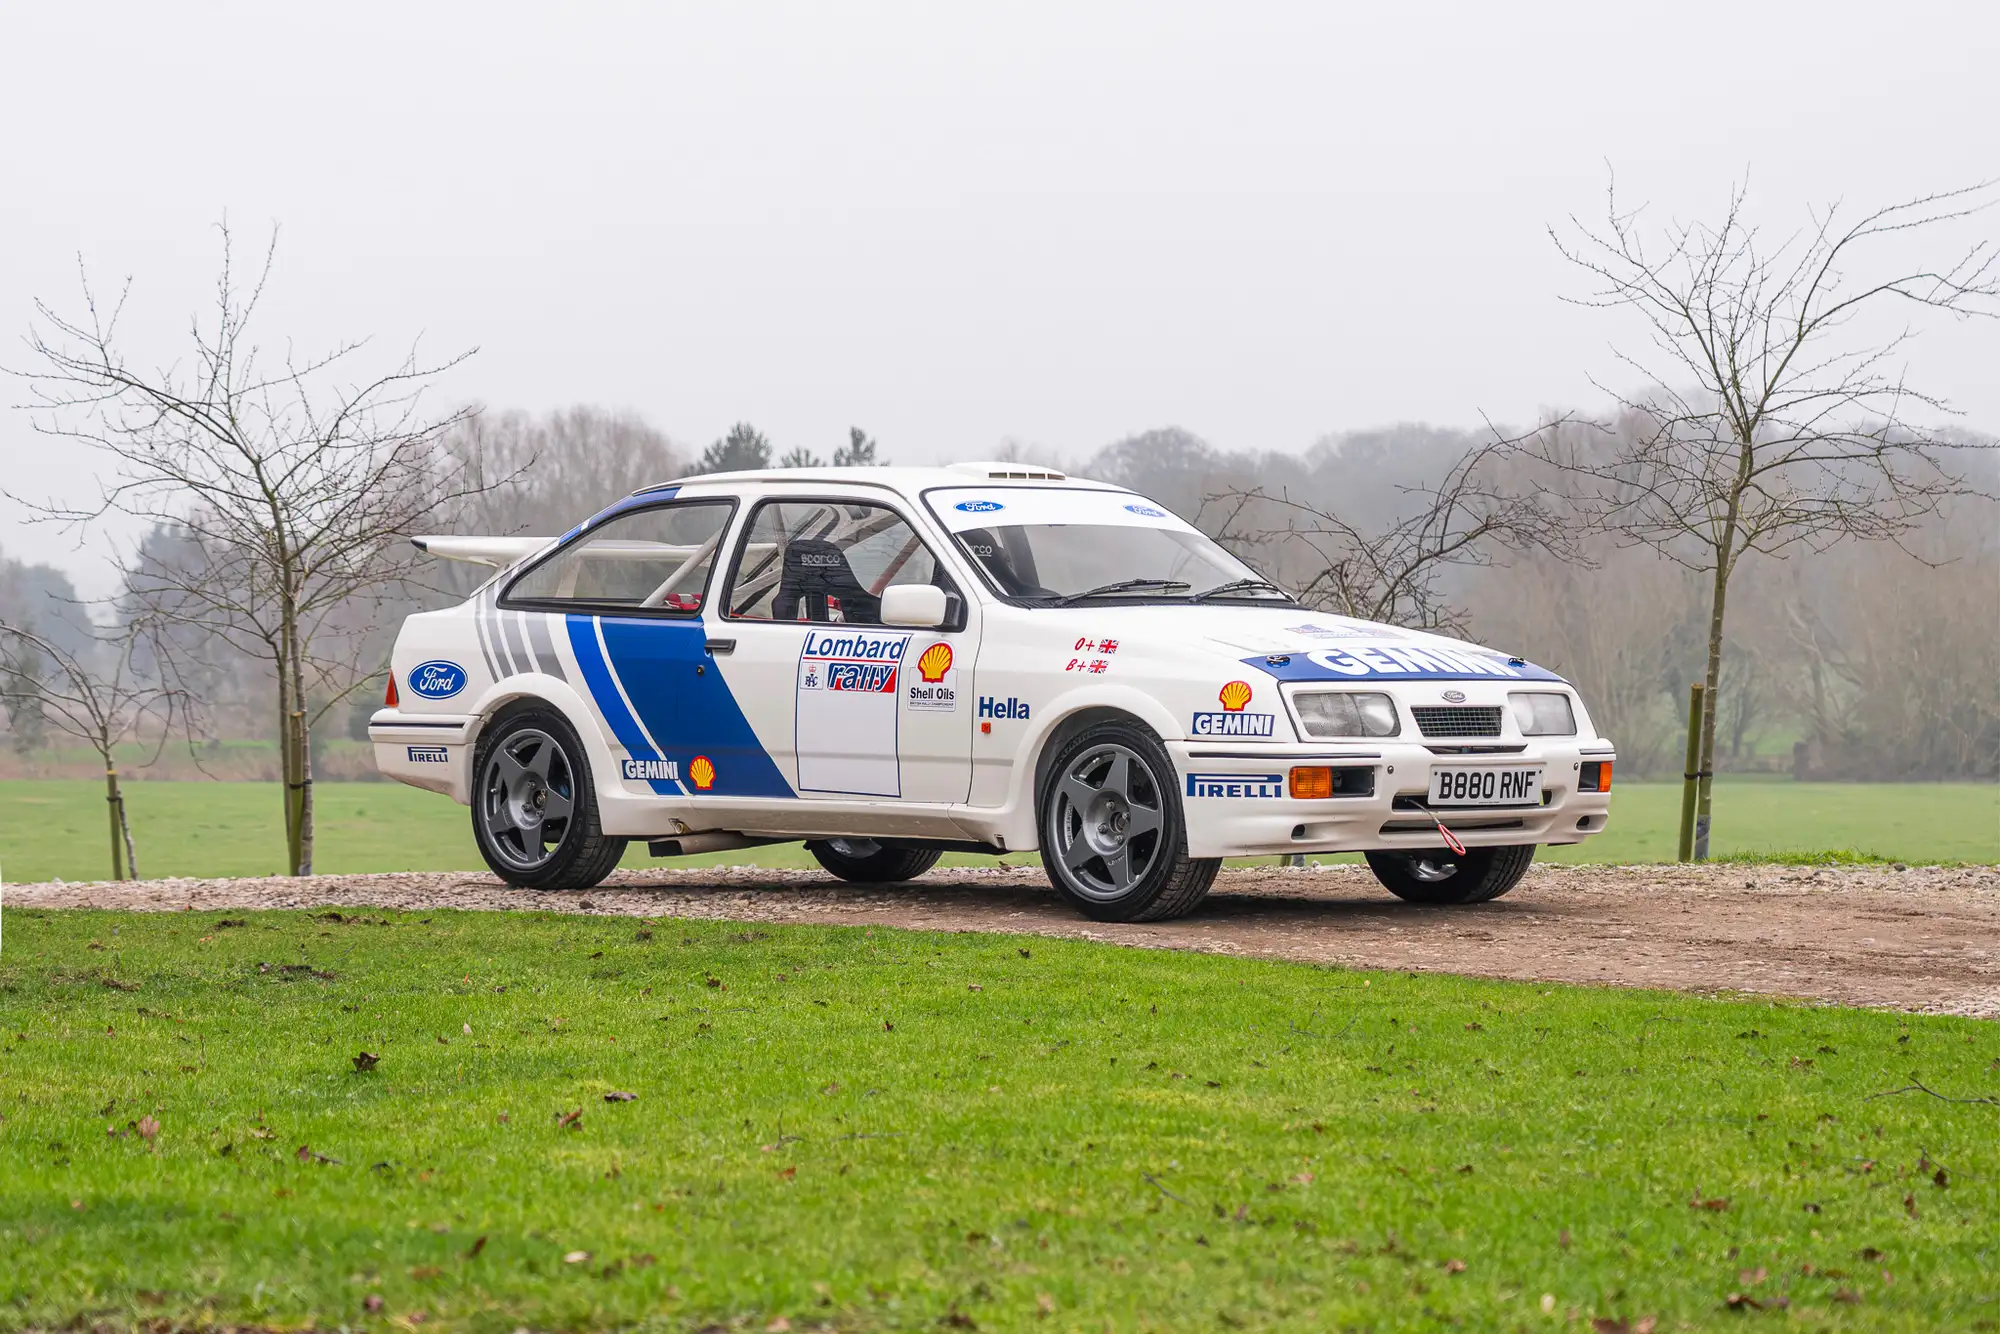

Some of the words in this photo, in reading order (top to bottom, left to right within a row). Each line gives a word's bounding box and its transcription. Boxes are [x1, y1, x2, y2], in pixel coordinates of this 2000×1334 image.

[965, 501, 995, 511] Ford
[805, 632, 908, 659] Lombard
[1306, 647, 1523, 677] GEMINI
[419, 665, 456, 691] Ford
[828, 664, 895, 692] rally
[910, 687, 934, 699] Shell
[936, 688, 955, 700] Oils
[979, 696, 1030, 719] Hella
[1195, 714, 1272, 735] GEMINI
[407, 747, 449, 762] PIRELLI
[625, 760, 679, 779] GEMINI
[1186, 773, 1283, 798] PIRELLI
[1438, 771, 1495, 799] B880
[1499, 770, 1536, 799] RNF
